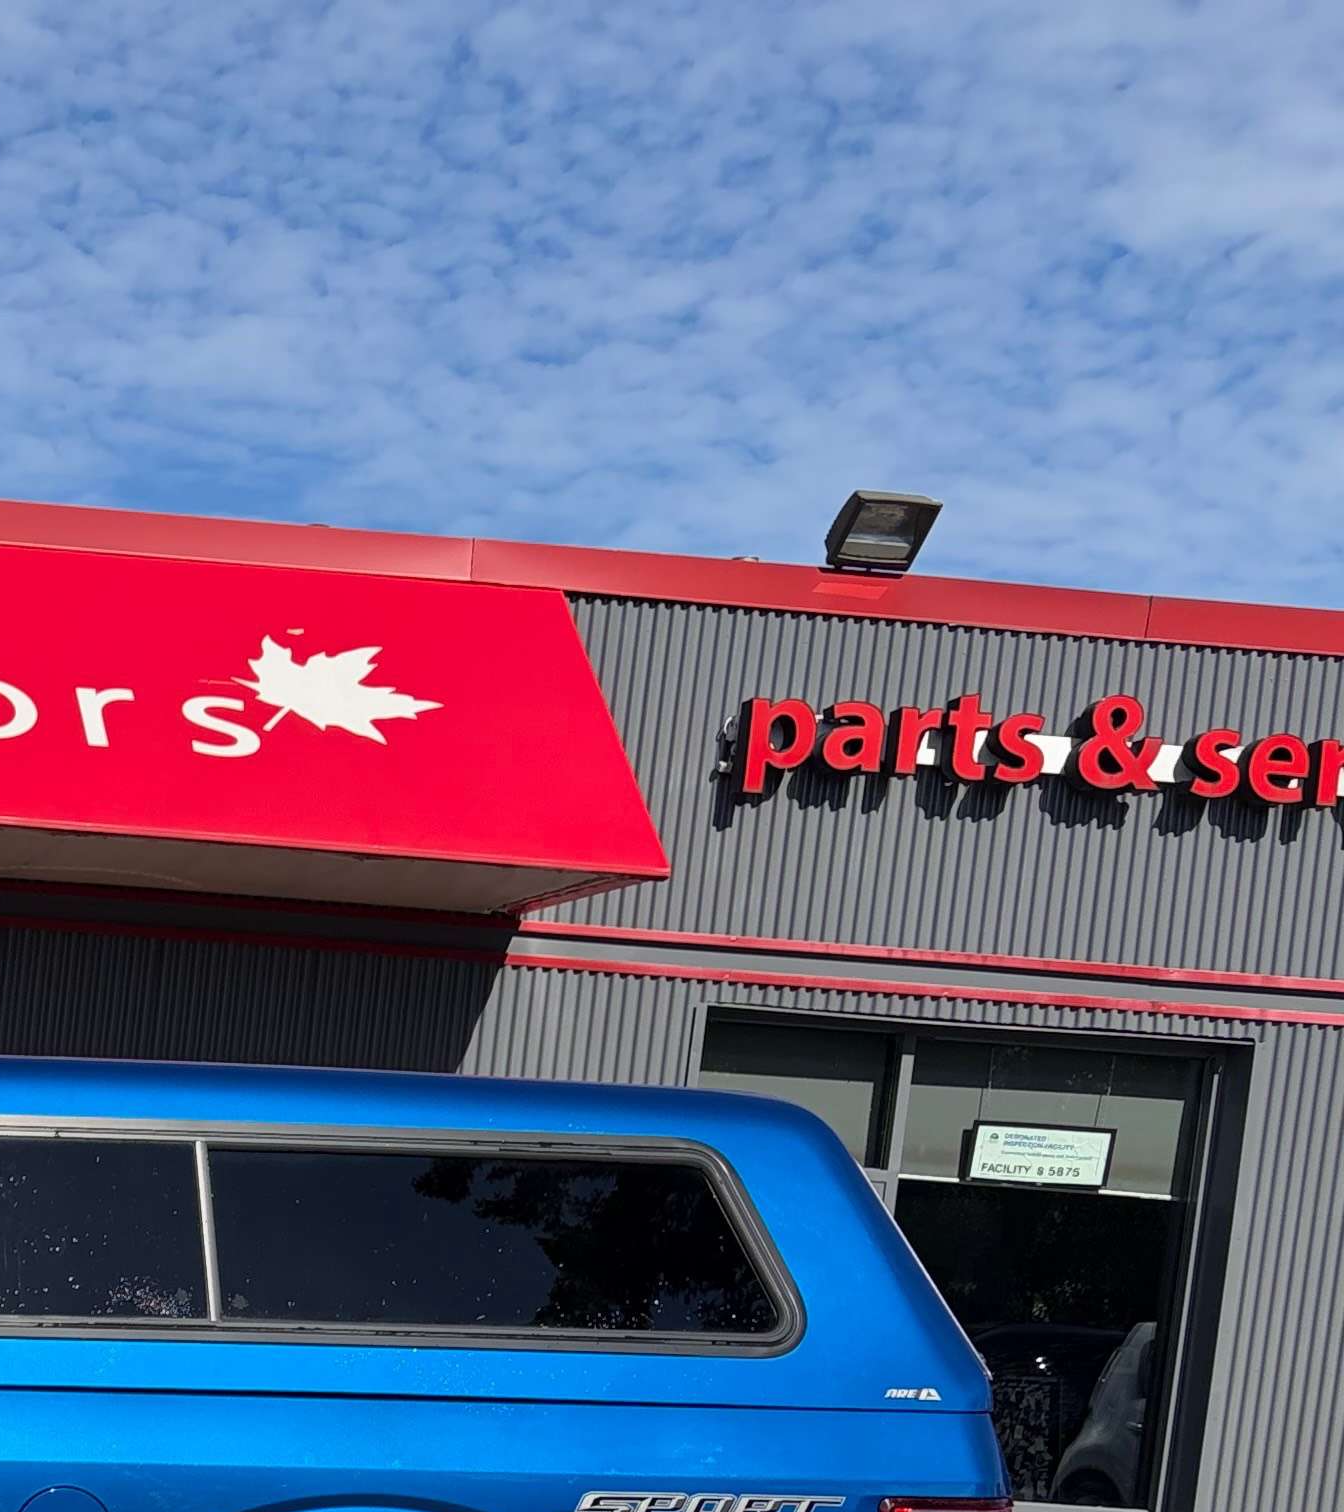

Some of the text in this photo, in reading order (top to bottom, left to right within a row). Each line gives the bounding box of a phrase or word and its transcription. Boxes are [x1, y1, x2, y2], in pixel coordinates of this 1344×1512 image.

[742, 694, 1344, 806] parts & ser
[980, 1162, 1031, 1175] FACILITY
[1048, 1166, 1080, 1178] 5875
